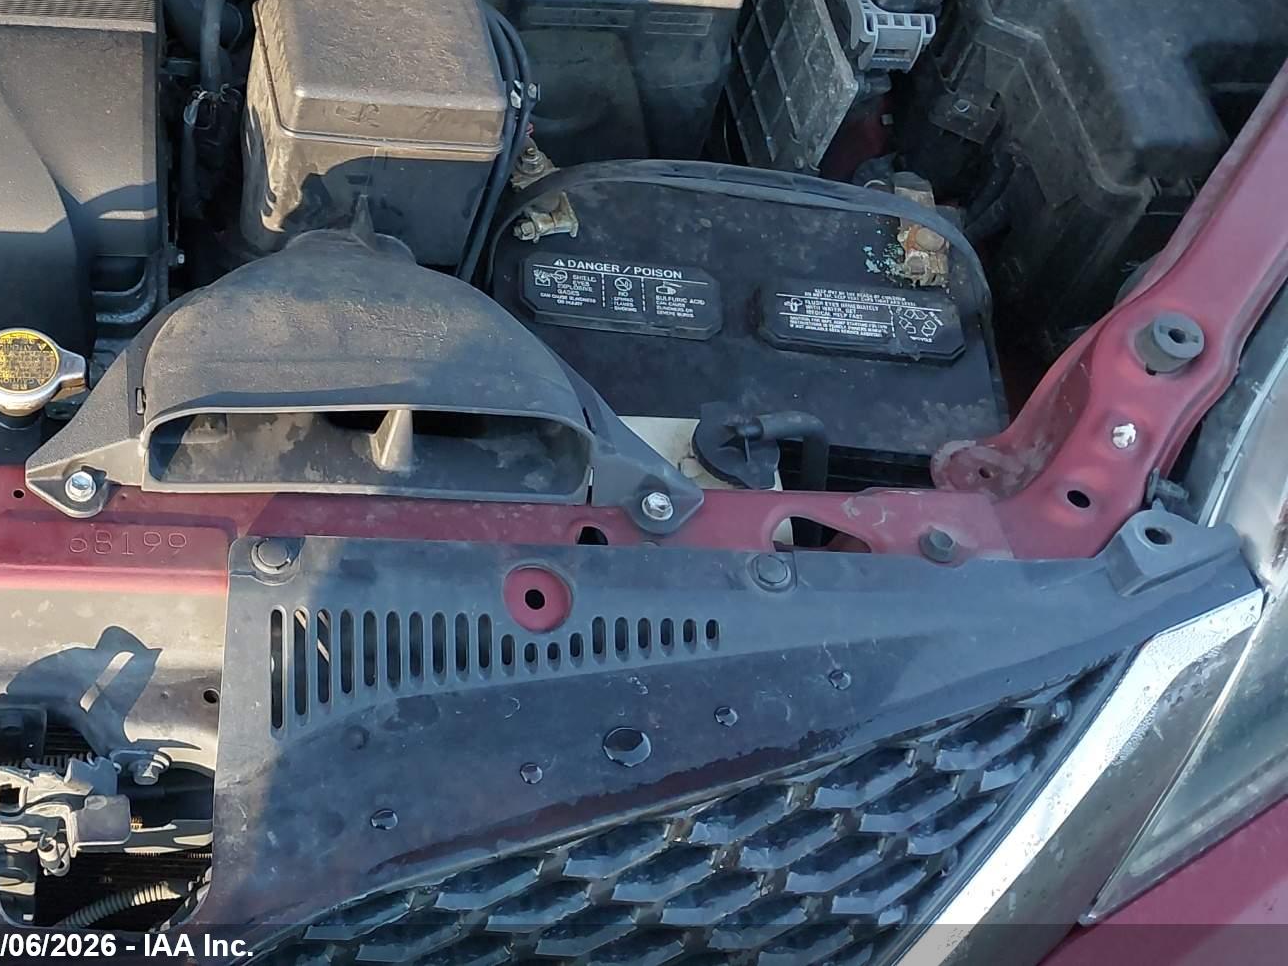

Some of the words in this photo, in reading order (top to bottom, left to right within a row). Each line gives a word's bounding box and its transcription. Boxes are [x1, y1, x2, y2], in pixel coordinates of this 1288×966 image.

[567, 259, 620, 273] DANGER
[633, 266, 683, 279] POISON
[572, 274, 597, 283] SHIELD
[557, 283, 593, 292] EXPLOSIVE
[655, 295, 688, 304] SULFURIC
